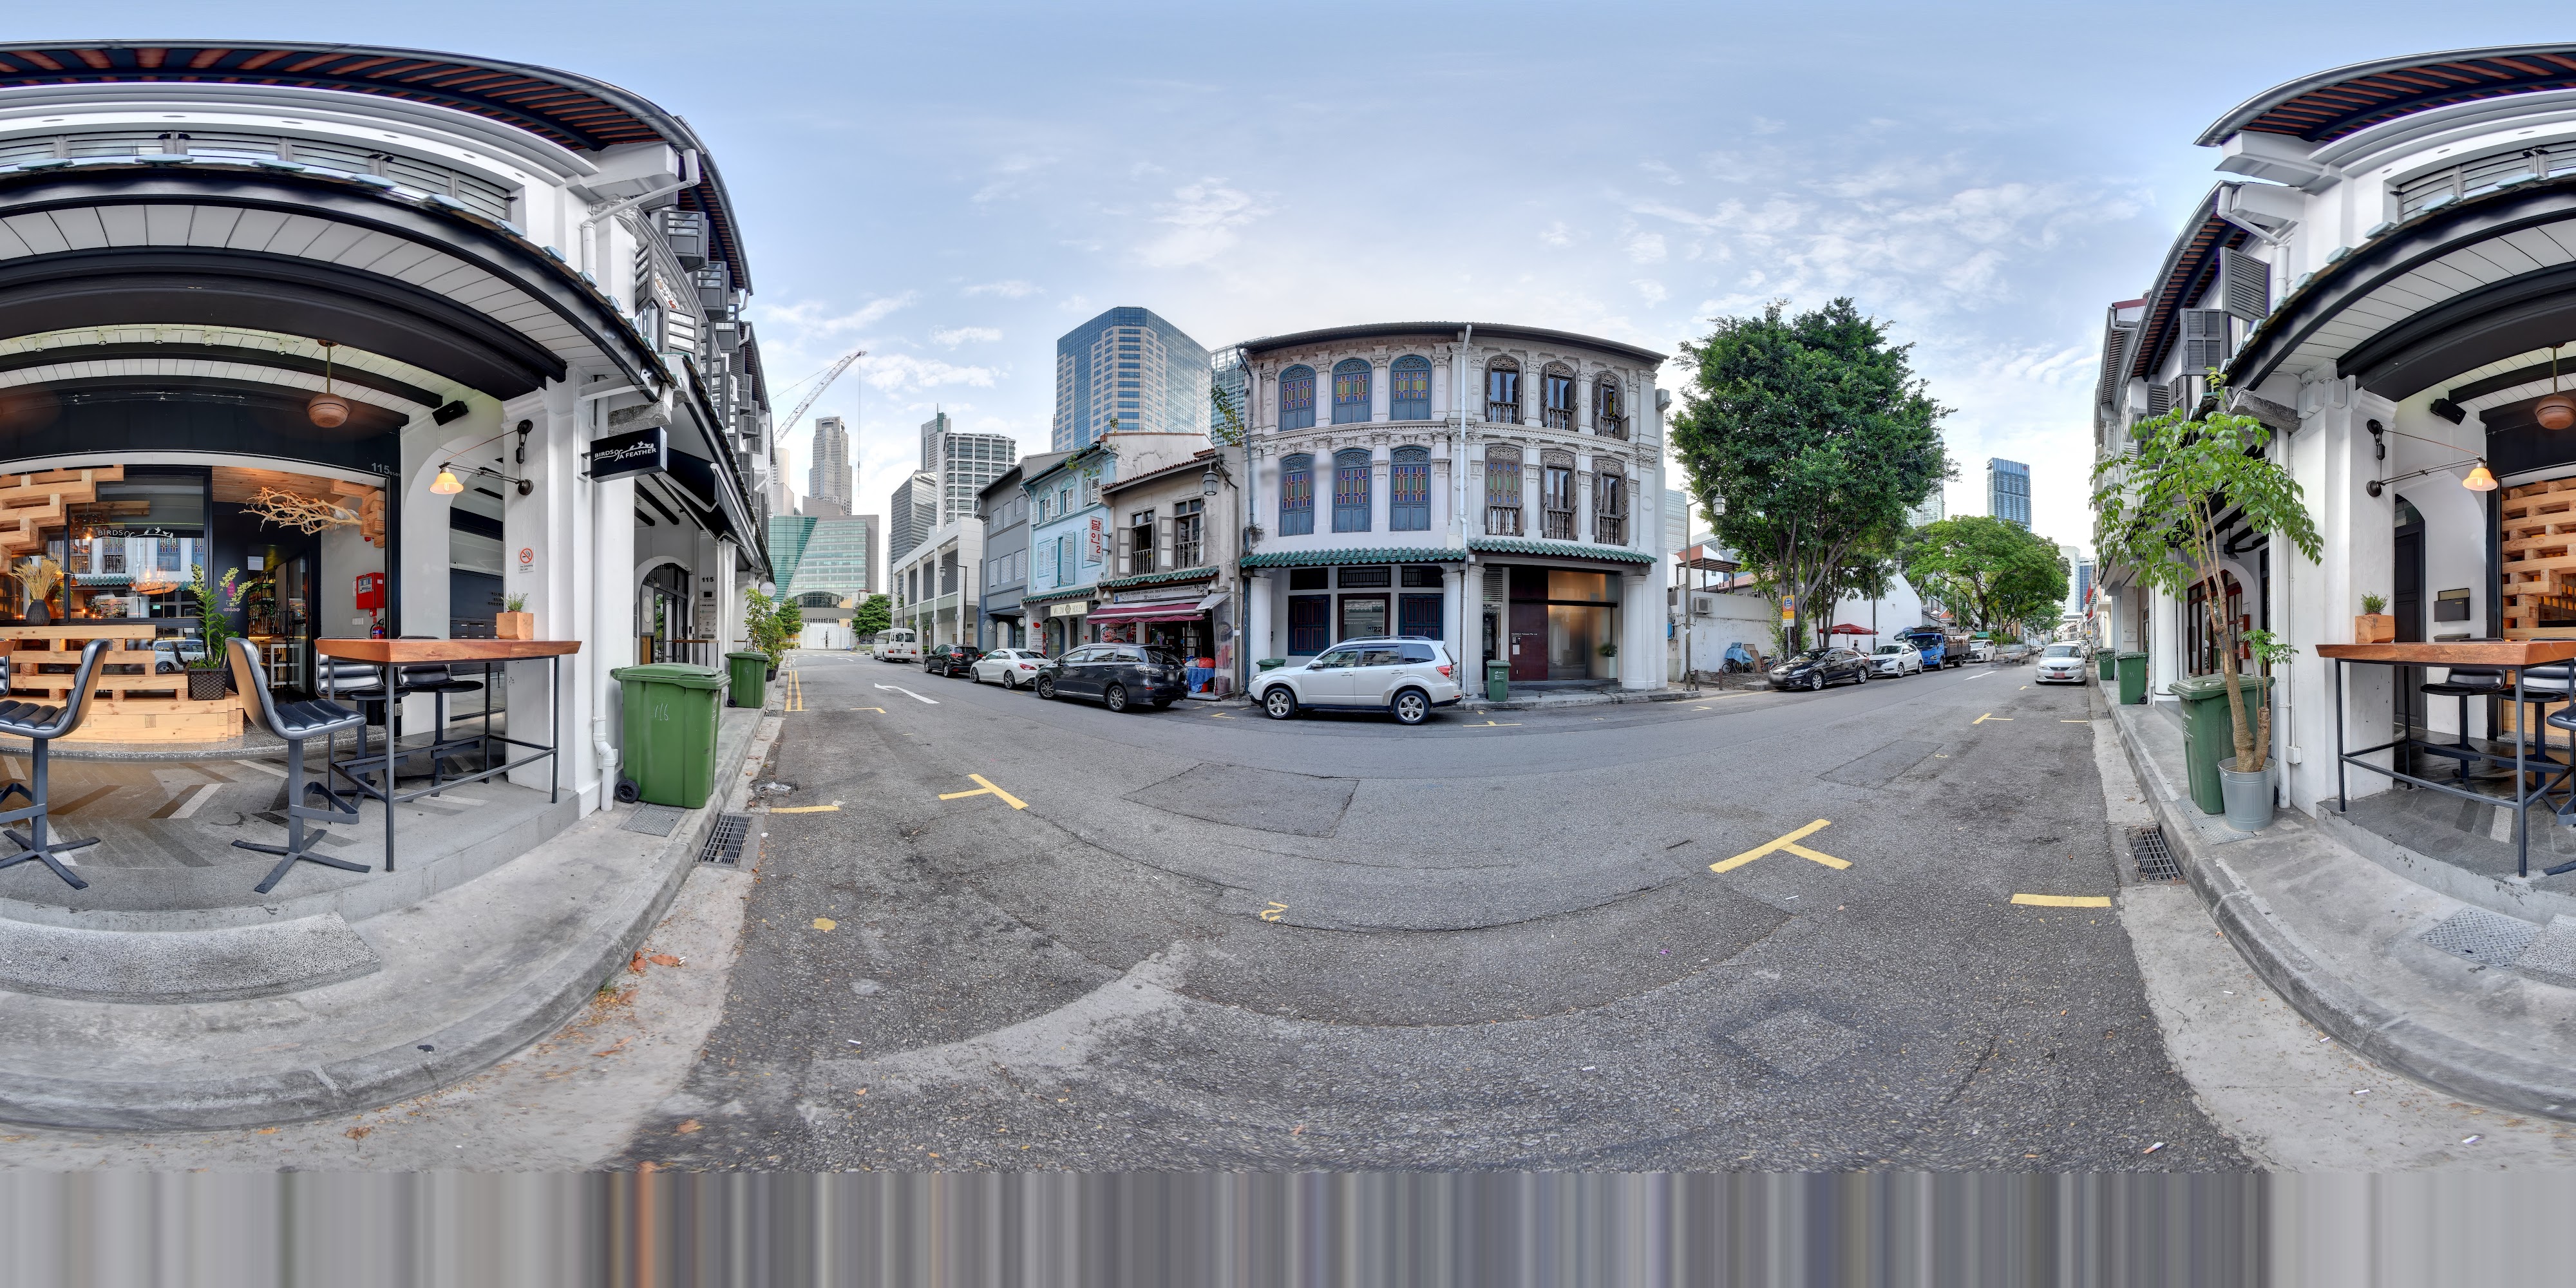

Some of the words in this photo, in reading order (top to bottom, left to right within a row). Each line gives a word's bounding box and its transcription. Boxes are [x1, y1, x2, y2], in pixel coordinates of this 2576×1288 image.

[594, 450, 614, 458] BIRDS
[625, 448, 657, 458] FEATHER
[372, 462, 390, 475] 115
[1072, 604, 1083, 612] HUXLEY
